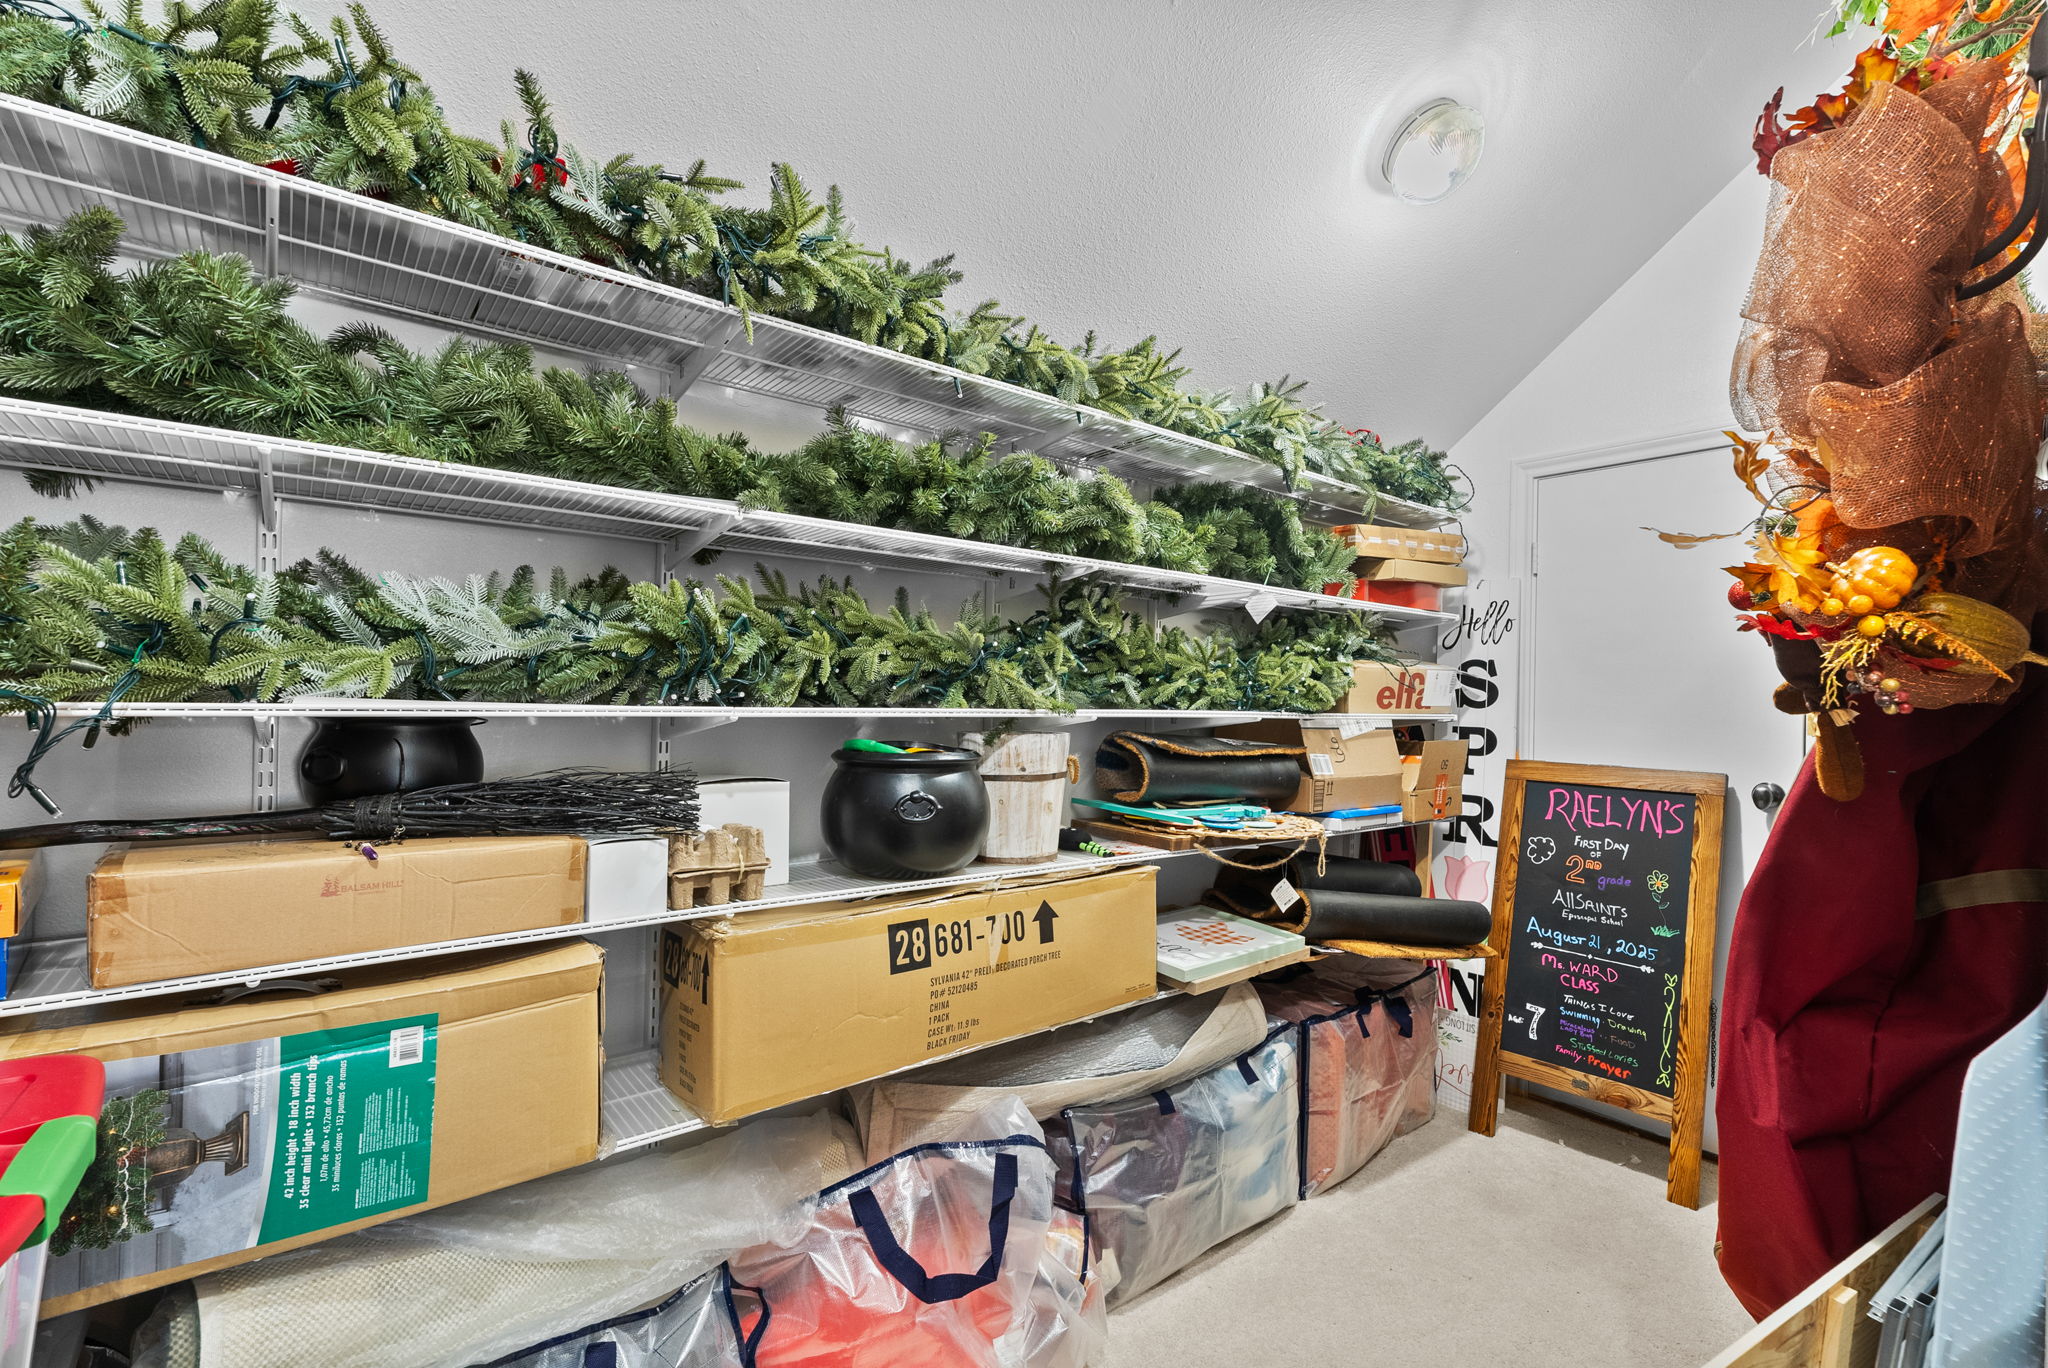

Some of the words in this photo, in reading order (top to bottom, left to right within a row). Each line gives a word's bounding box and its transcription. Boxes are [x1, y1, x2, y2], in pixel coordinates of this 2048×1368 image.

[1442, 600, 1516, 650] Hello
[1544, 788, 1685, 839] RAELYN'S
[341, 882, 380, 892] BALSAM
[382, 880, 402, 889] HILL
[1598, 876, 1632, 890] grade
[1601, 916, 1623, 927] School
[895, 927, 926, 965] 28
[1616, 940, 1659, 961] 2025
[665, 940, 680, 979] 28
[930, 973, 960, 987] SYLVANIA
[974, 966, 995, 977] PRELI
[996, 959, 1028, 972] DECORATED
[1029, 954, 1047, 965] PORCH
[1048, 950, 1061, 960] TREE
[1569, 961, 1618, 982] WARD
[947, 981, 978, 996] 52120485
[1560, 974, 1600, 994] CLASS
[930, 1000, 949, 1012] CHINA
[1598, 1004, 1607, 1012] I
[934, 1012, 949, 1024] PACK
[1445, 1016, 1465, 1030] LONG
[1526, 1003, 1546, 1040] 7
[928, 1026, 944, 1038] CASE
[958, 1020, 969, 1030] 11.9
[927, 1037, 947, 1050] BLACK
[949, 1031, 970, 1044] FRIDAY
[307, 1055, 320, 1070] tips
[1588, 1055, 1631, 1079] Prayer
[290, 1073, 301, 1097] width
[305, 1073, 317, 1102] branch
[325, 1075, 334, 1095] ancho
[337, 1082, 346, 1090] de
[288, 1100, 299, 1117] inch
[324, 1097, 332, 1105] de
[305, 1105, 315, 1119] 132
[323, 1107, 332, 1133] 45,72cm
[336, 1115, 344, 1126] 132
[288, 1120, 298, 1129] 18
[302, 1129, 315, 1152] lights
[321, 1140, 330, 1152] alto
[285, 1139, 299, 1166] height
[320, 1154, 329, 1162] de
[301, 1155, 312, 1173] mini
[332, 1153, 342, 1182] miniluces
[283, 1168, 295, 1186] inch
[299, 1176, 310, 1196] clear
[284, 1188, 294, 1199] 42
[332, 1184, 339, 1192] 35
[299, 1199, 309, 1209] 35
